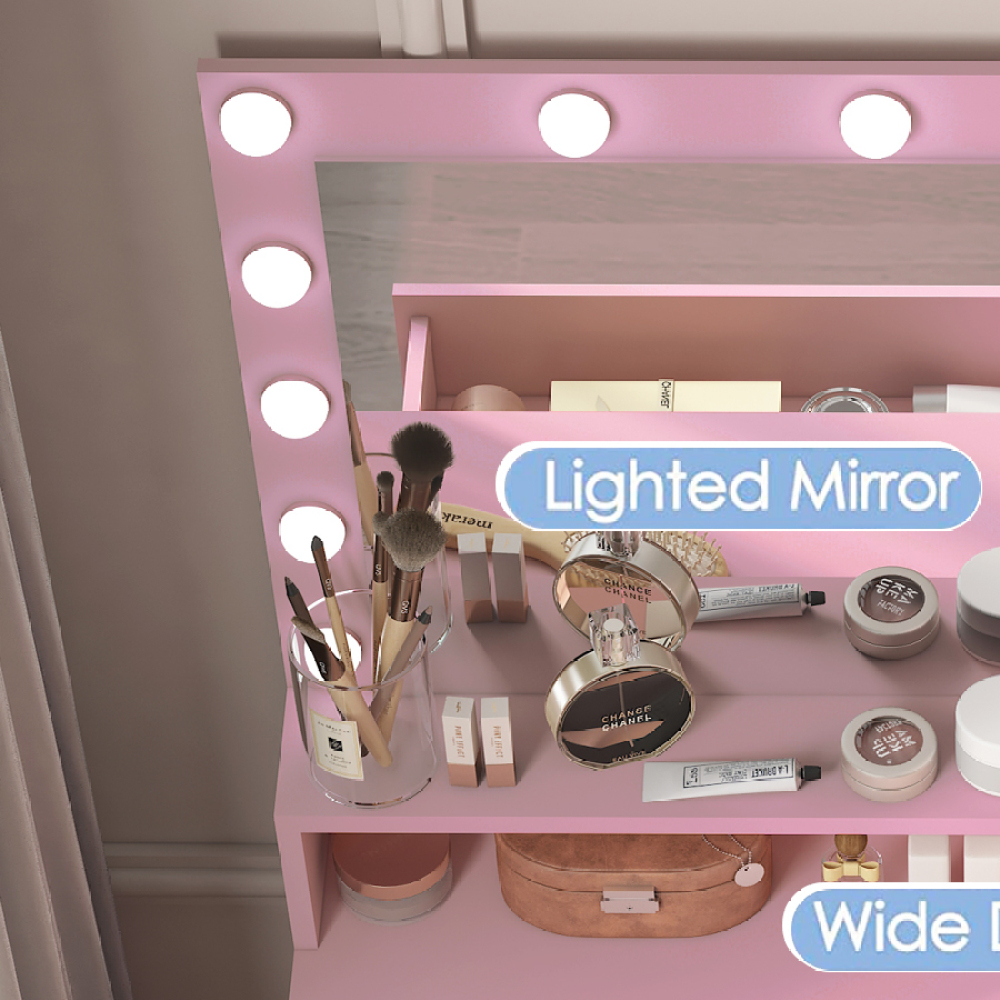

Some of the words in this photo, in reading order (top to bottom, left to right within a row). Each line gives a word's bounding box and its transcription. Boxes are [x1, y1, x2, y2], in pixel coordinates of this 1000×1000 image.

[603, 577, 652, 596] CHANCE
[604, 586, 652, 604] CHANEL
[601, 704, 652, 724] CHANCE
[601, 715, 653, 732] CHANEL
